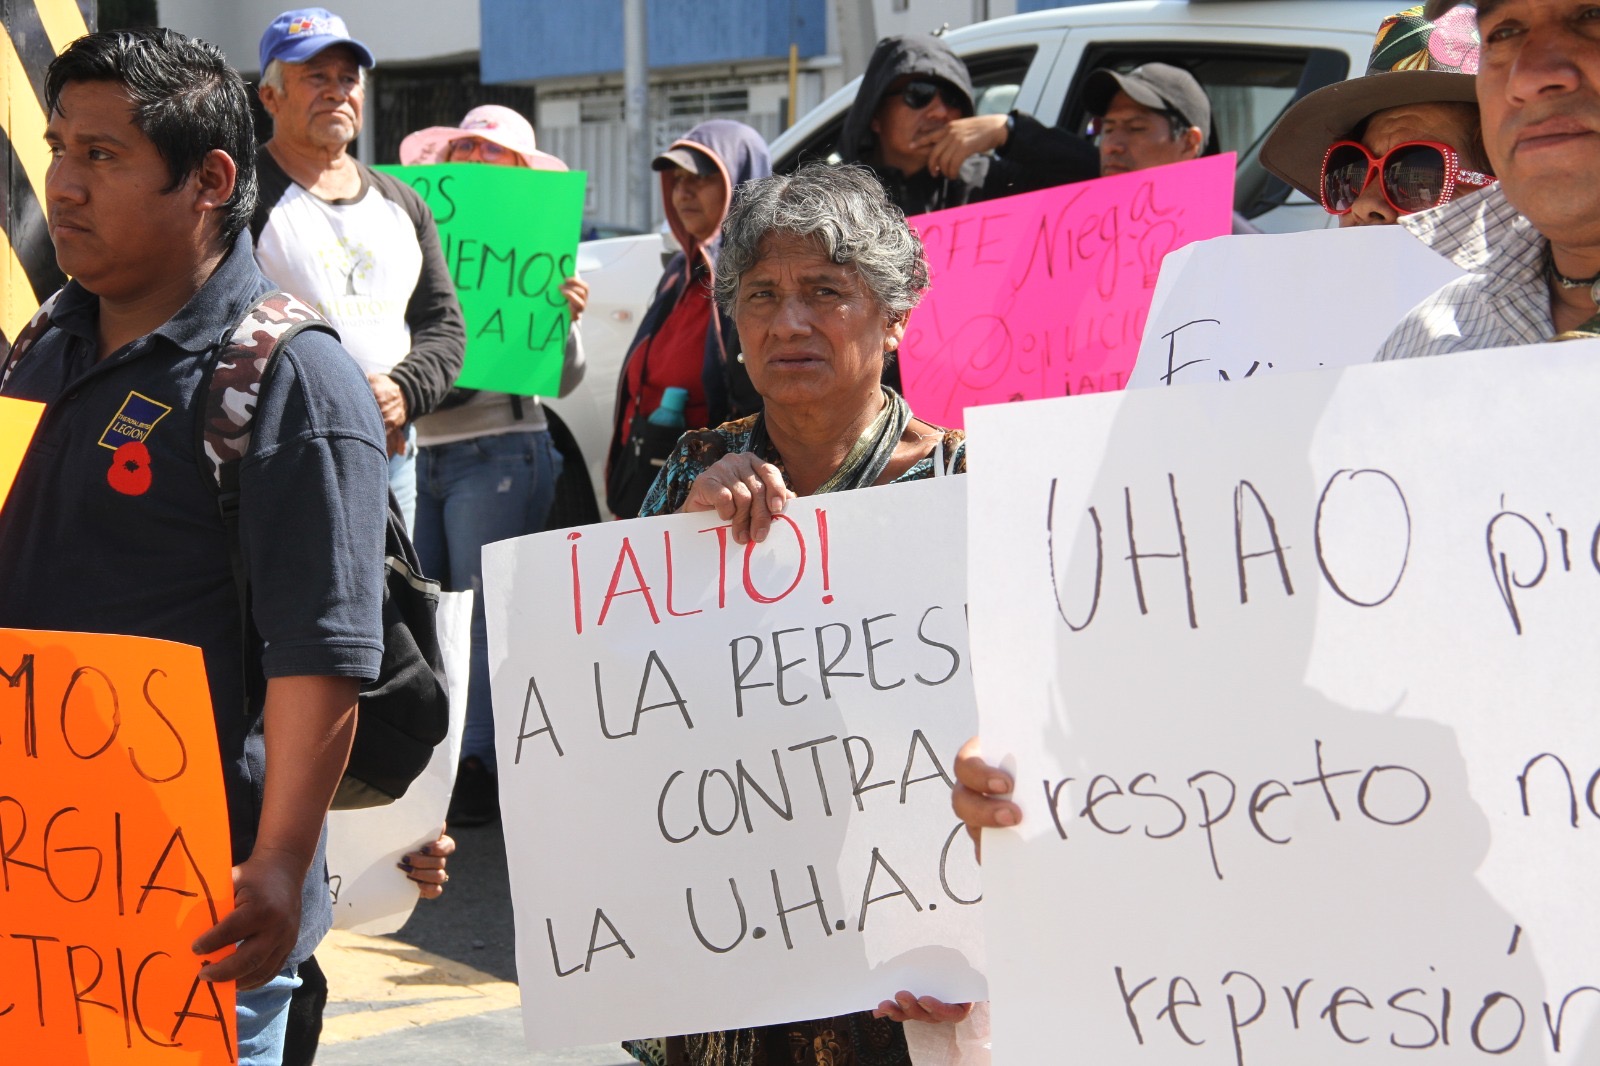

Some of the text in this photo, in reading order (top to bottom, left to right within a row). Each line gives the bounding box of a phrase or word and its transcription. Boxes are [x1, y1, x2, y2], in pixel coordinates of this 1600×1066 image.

[475, 308, 566, 355] A LA
[112, 422, 146, 439] LEGION
[1047, 468, 1411, 632] UHAO
[514, 676, 564, 765] A
[593, 649, 695, 740] LA
[657, 728, 953, 844] CONTRA
[1042, 738, 1431, 881] respeto
[0, 795, 219, 925] RGIA
[546, 907, 636, 978] LA
